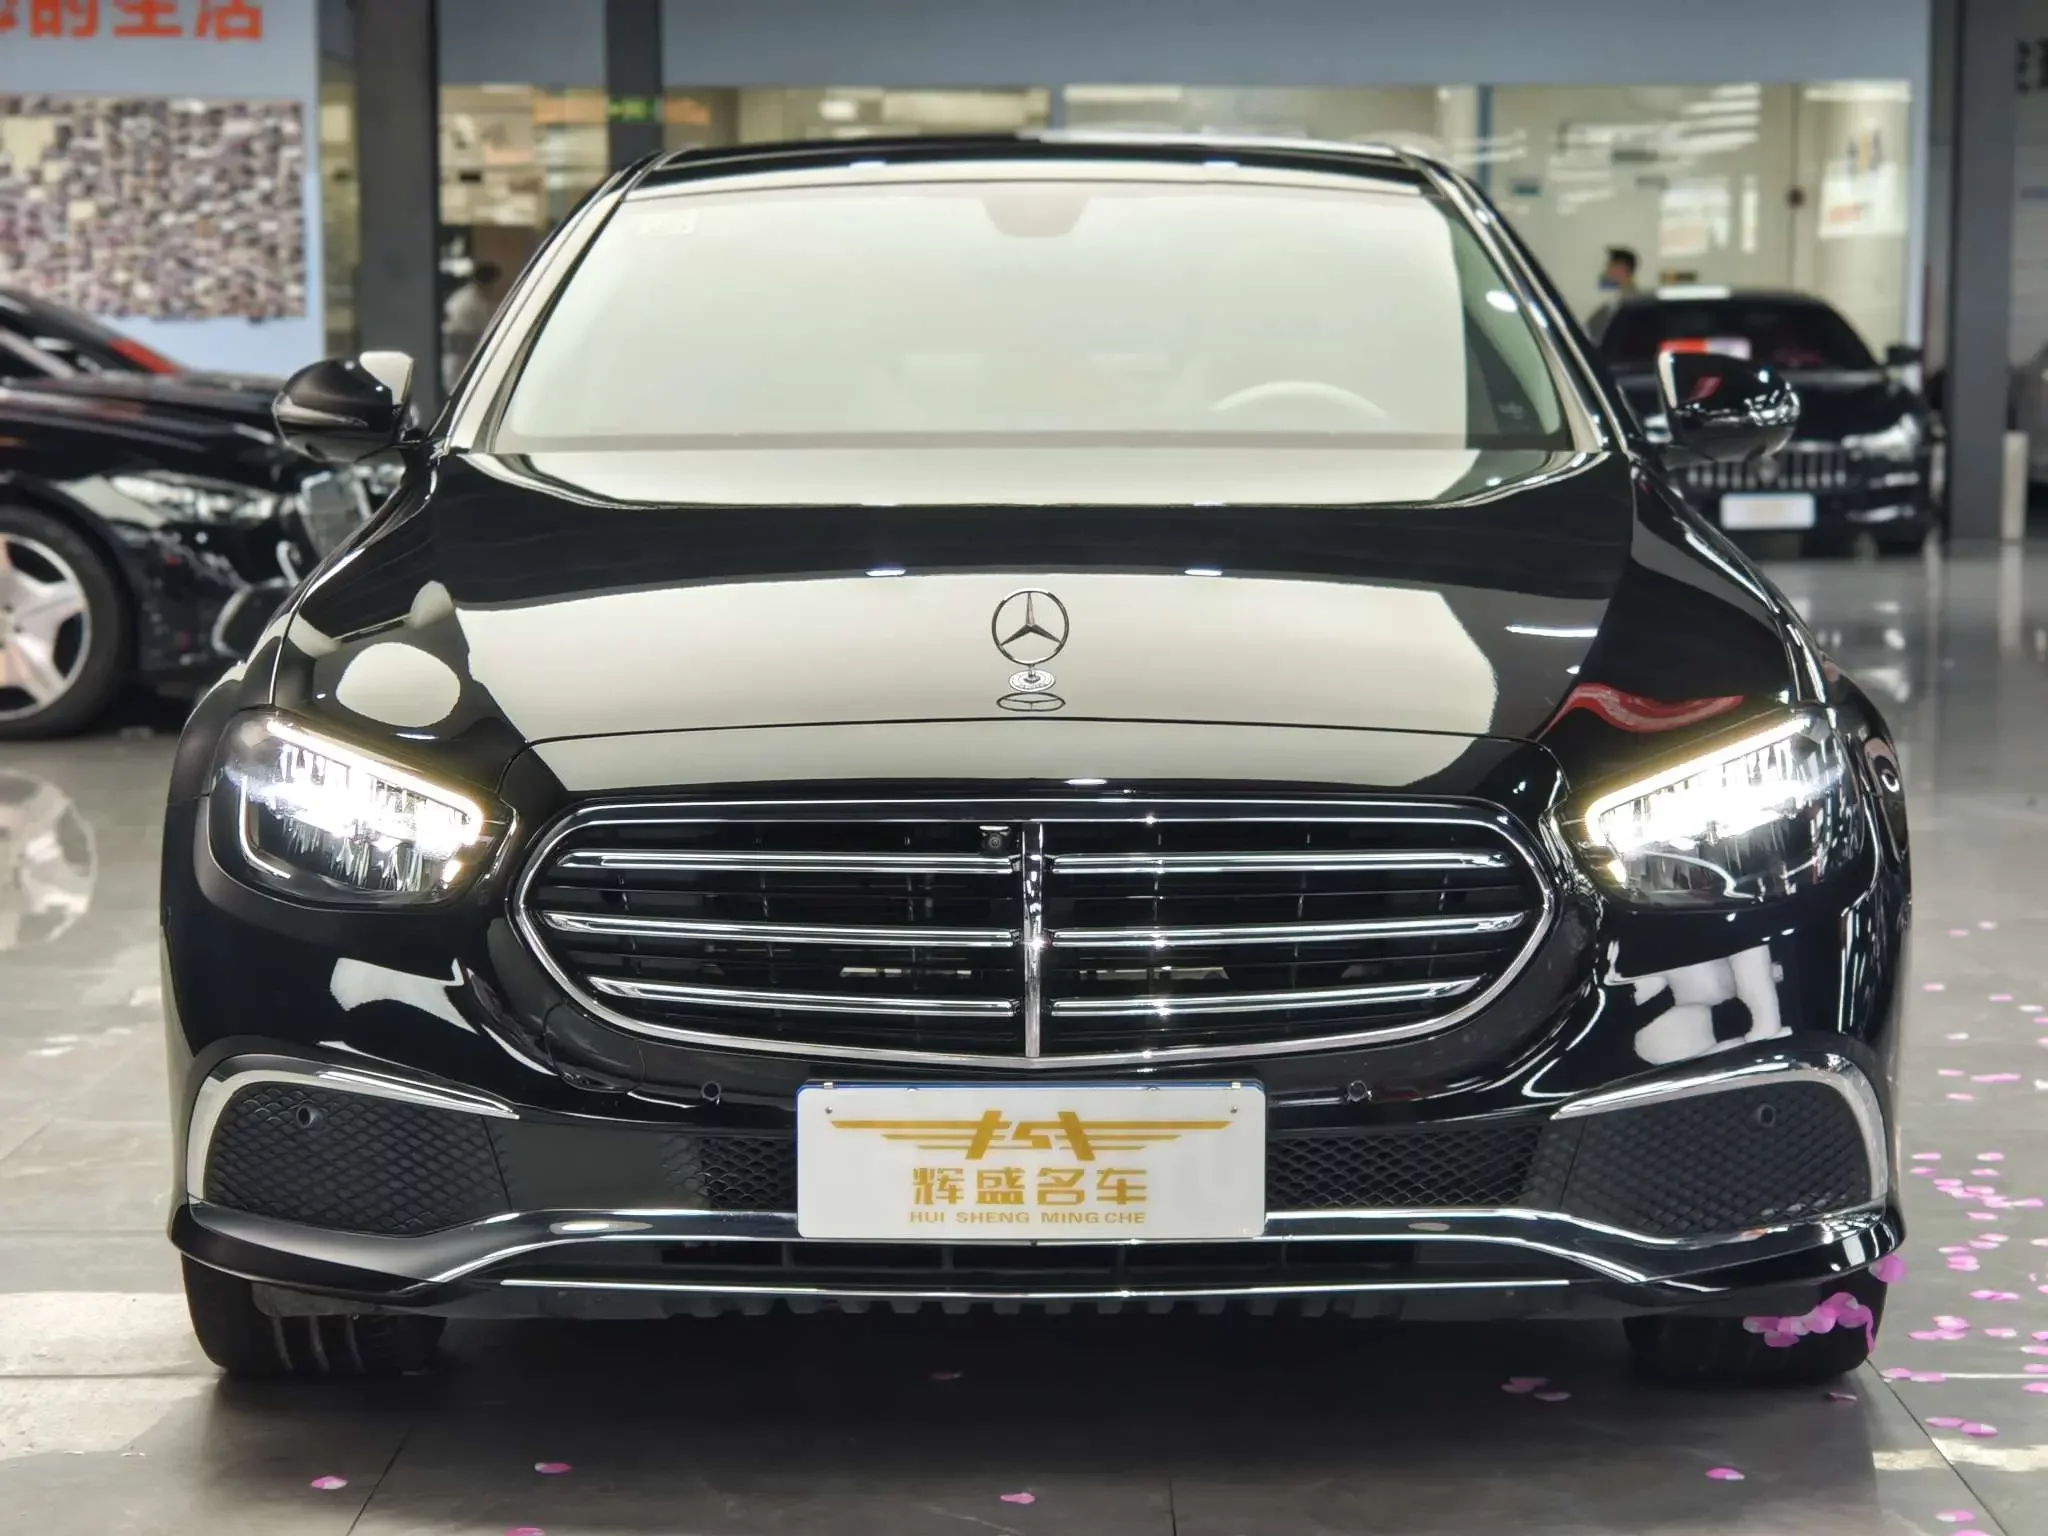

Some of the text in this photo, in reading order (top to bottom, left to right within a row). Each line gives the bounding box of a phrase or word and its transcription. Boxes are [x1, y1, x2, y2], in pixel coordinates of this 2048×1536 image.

[0, 0, 262, 41] 的生活
[911, 1166, 1147, 1206] 辉盛名车
[909, 1212, 945, 1224] HUI
[956, 1212, 1030, 1224] SHENG
